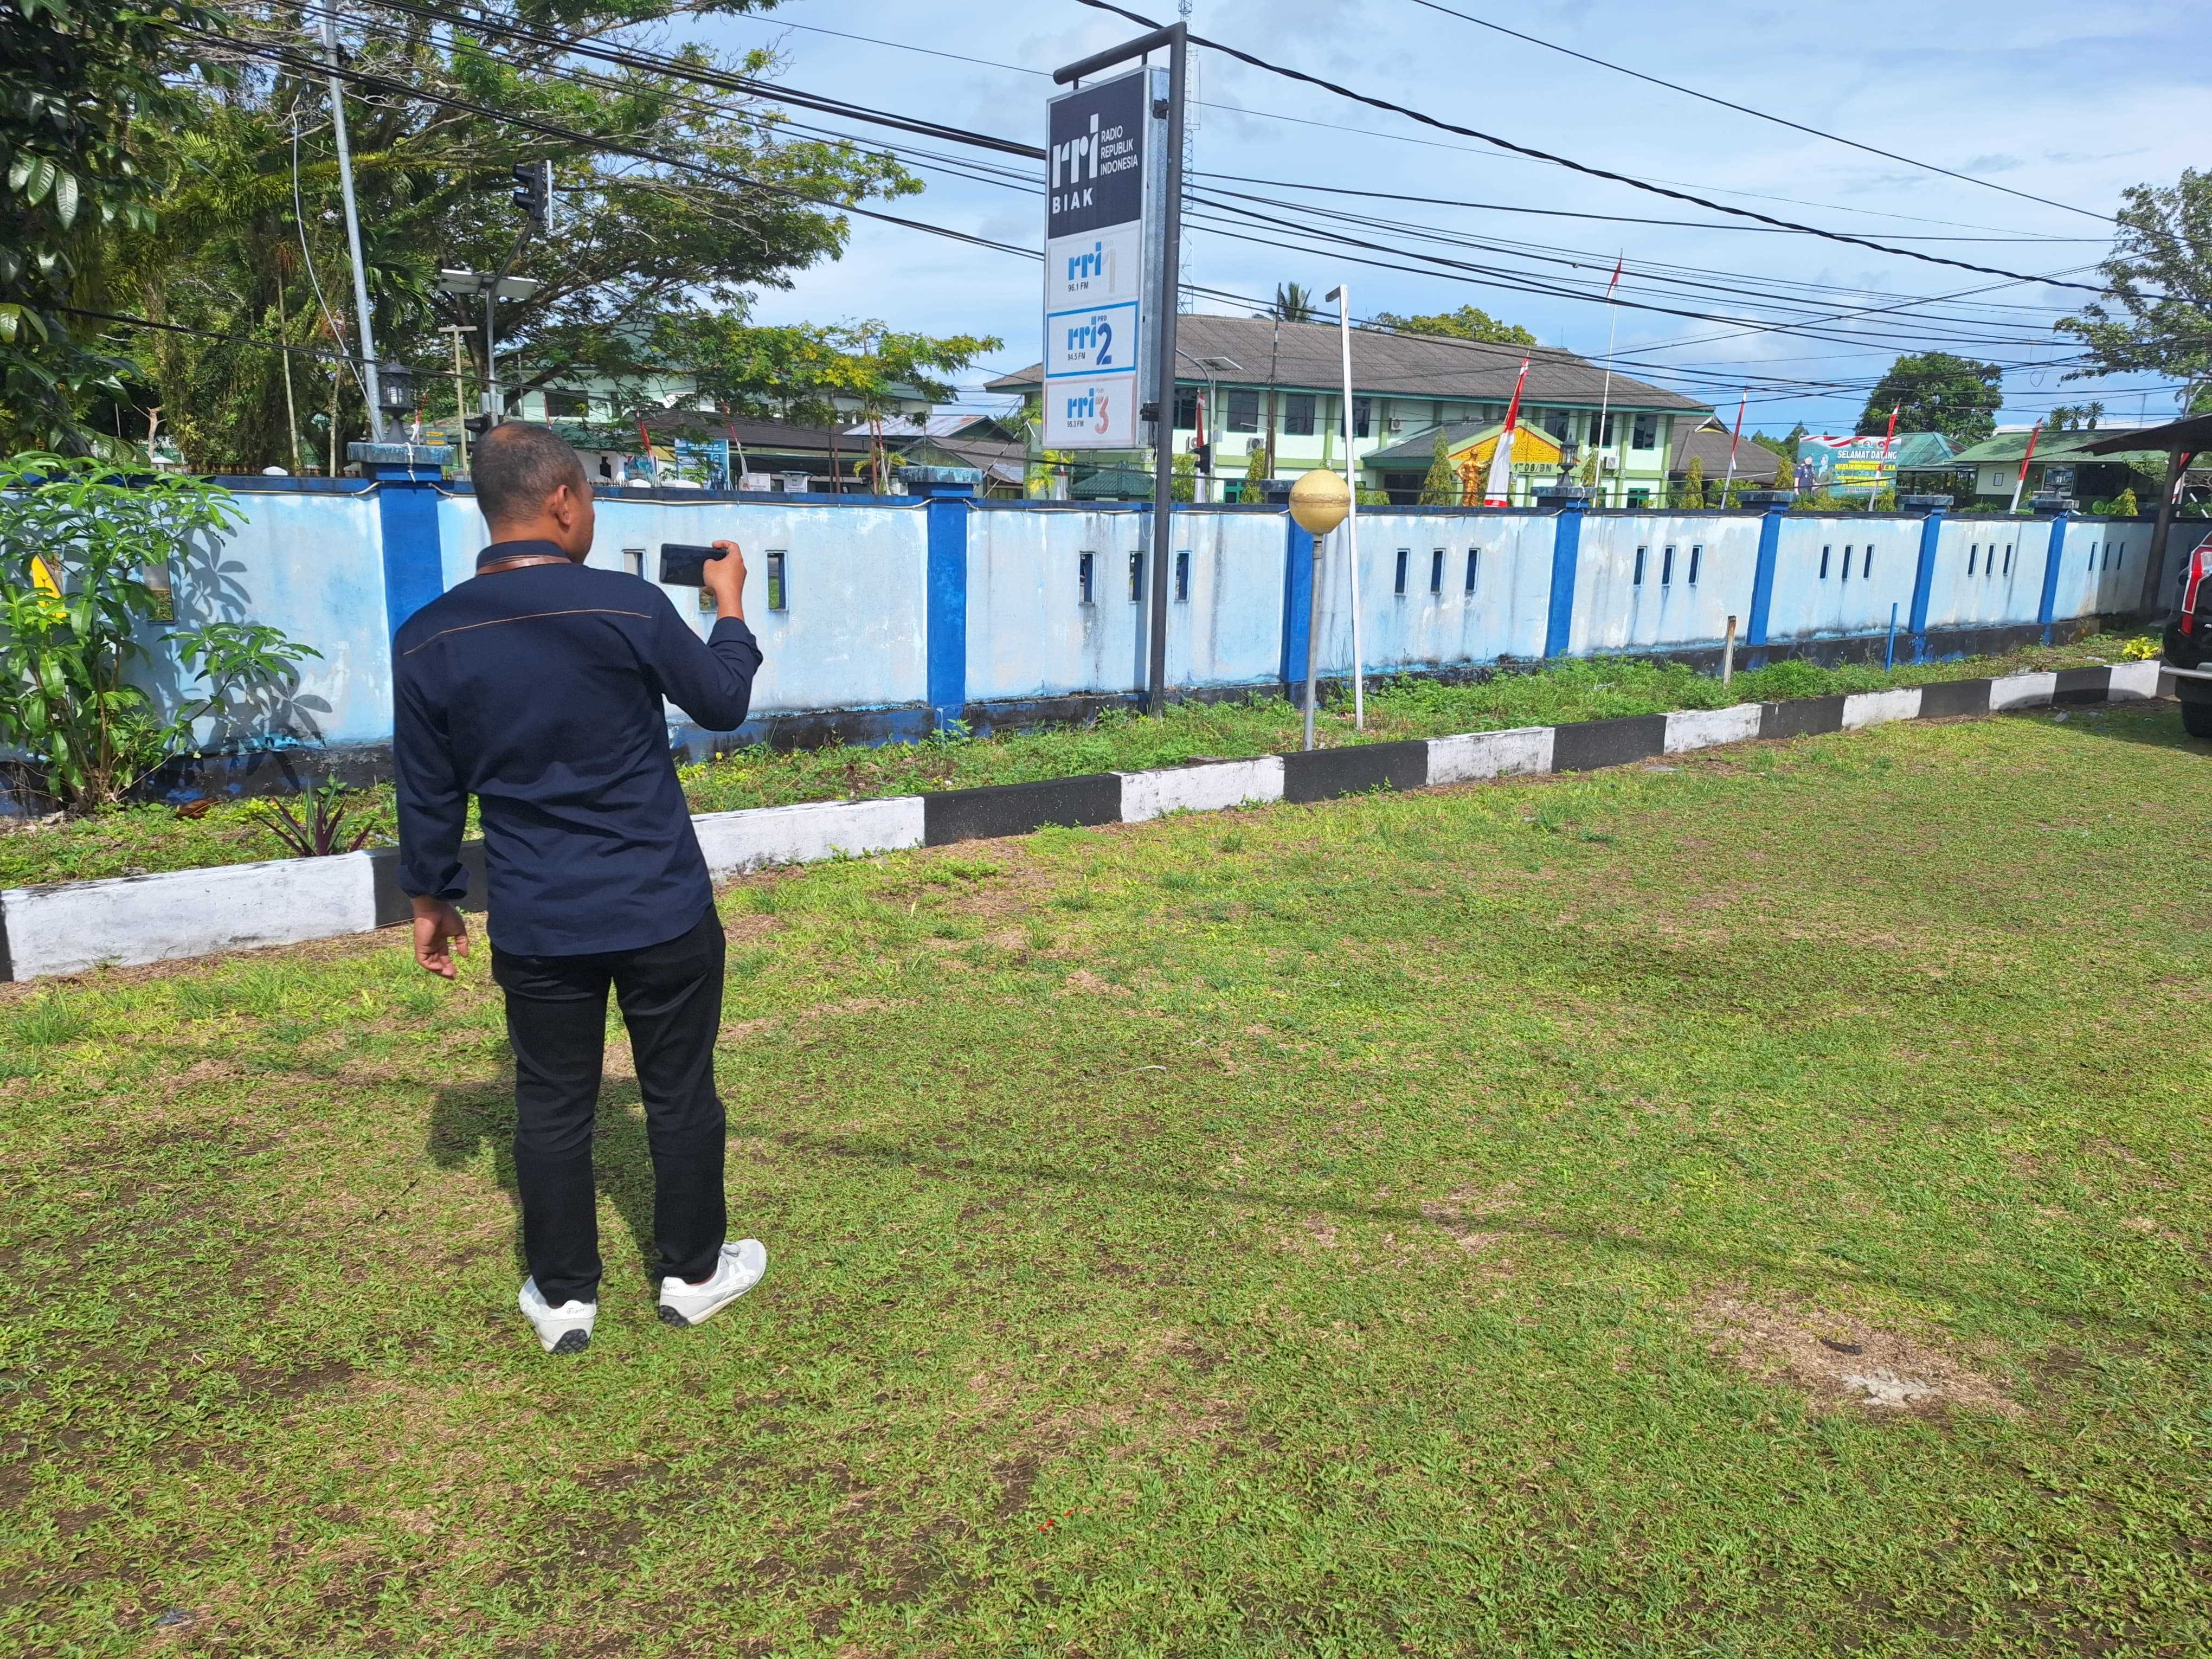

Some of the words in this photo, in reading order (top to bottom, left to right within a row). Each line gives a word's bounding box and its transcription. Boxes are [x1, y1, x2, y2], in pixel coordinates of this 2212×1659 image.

[1101, 125, 1123, 143] RADIO
[1052, 113, 1099, 189] rri
[1101, 138, 1134, 159] REPUBLIK
[1100, 154, 1138, 176] INDONESIA
[1052, 187, 1093, 214] BIAK
[1068, 282, 1079, 292] 96.1
[1081, 281, 1089, 291] FM
[1096, 323, 1112, 366] 2
[1068, 352, 1077, 361] 94.5
[1078, 352, 1086, 360] FM
[1095, 396, 1109, 434] 3
[1837, 450, 1870, 459] SELAMAT
